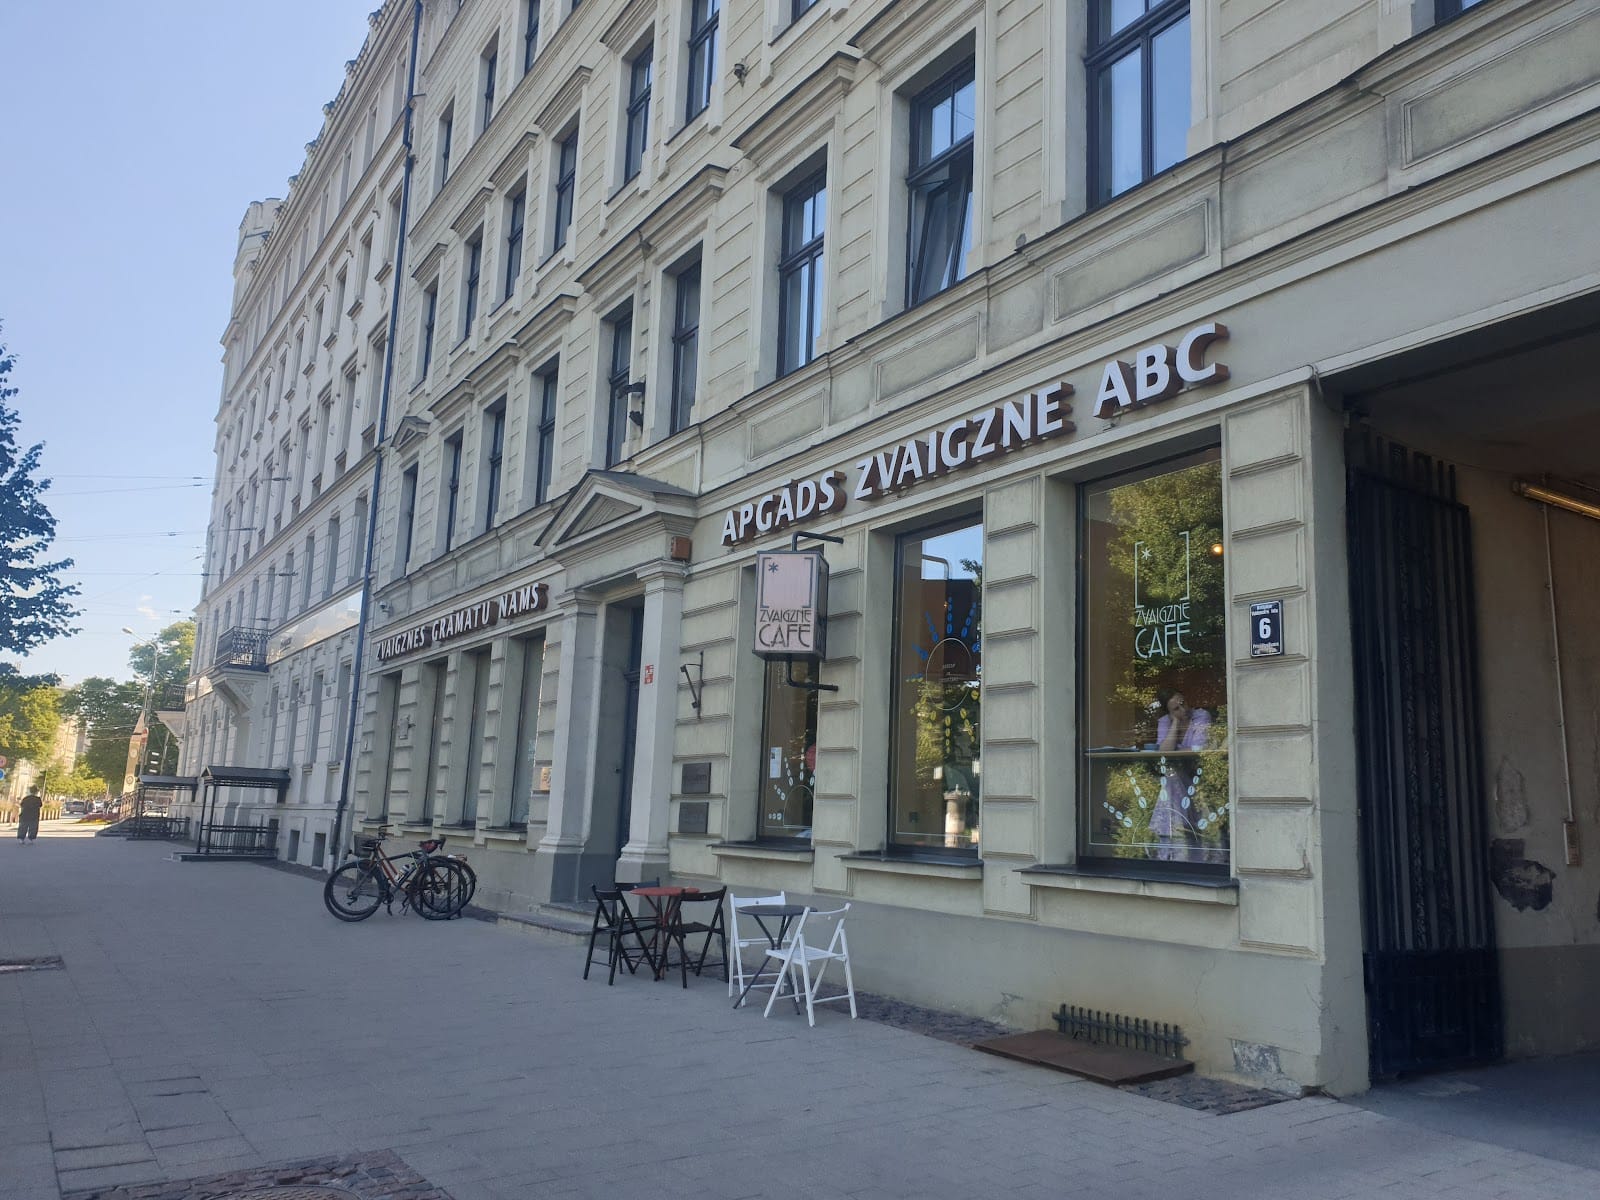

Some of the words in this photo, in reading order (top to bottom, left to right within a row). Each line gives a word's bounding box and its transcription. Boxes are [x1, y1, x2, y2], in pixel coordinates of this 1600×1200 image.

[853, 380, 1064, 501] ZVAIGZNE
[1092, 321, 1217, 418] ABC
[376, 625, 426, 661] ZVAIGZNES
[498, 581, 540, 619] NAMS
[759, 608, 813, 624] ZVAIGZNE
[1134, 602, 1191, 628] ZVAIGZNE
[1259, 617, 1272, 639] 6
[758, 623, 812, 648] CAFE
[1134, 621, 1191, 659] CAFE
